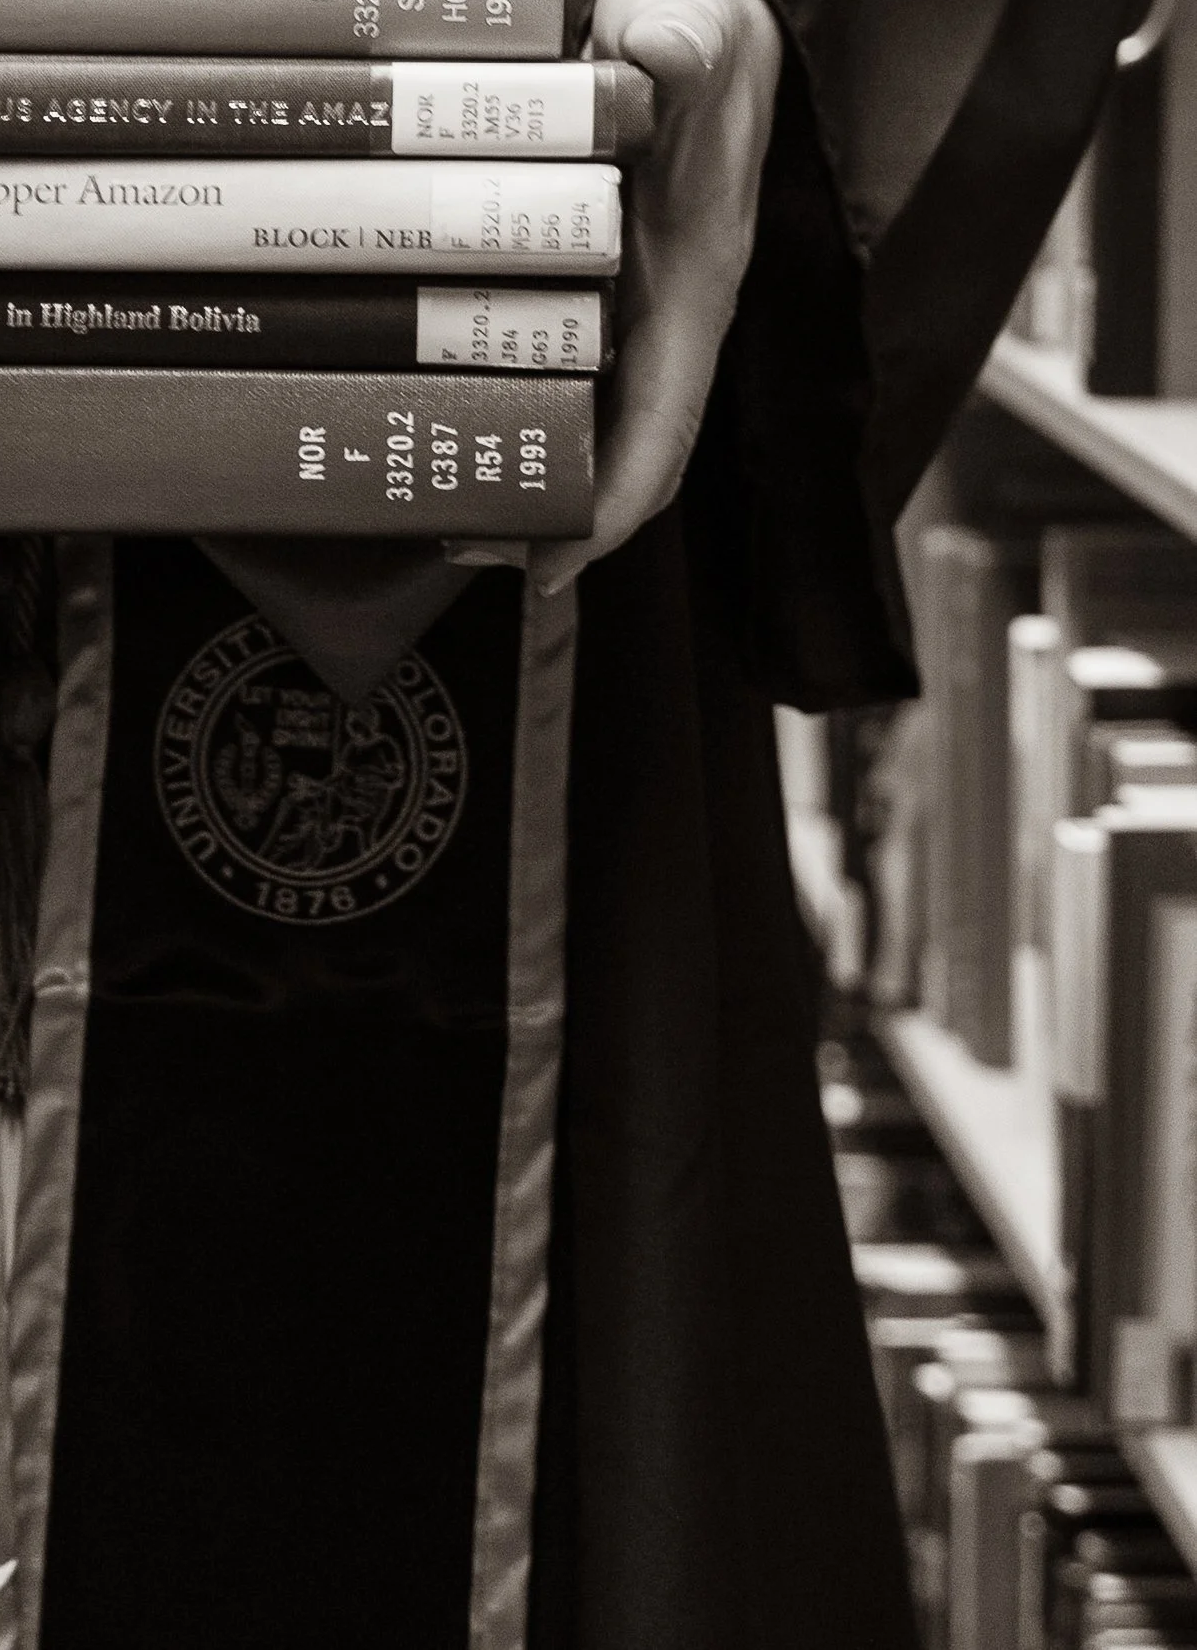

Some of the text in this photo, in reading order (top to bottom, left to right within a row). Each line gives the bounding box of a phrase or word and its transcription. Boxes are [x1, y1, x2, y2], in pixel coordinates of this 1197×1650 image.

[42, 97, 174, 124] AGENCY
[186, 99, 218, 125] IN
[228, 100, 290, 126] THE
[298, 101, 392, 127] AMAZ
[416, 94, 434, 139] NOR
[461, 81, 480, 141] 3320.2
[505, 102, 523, 139] V36
[527, 98, 545, 141] 2013
[439, 126, 455, 140] F
[75, 174, 224, 207] Amazon
[481, 178, 501, 250] 3320.2
[510, 212, 531, 251] M55
[540, 212, 561, 251] B56
[570, 201, 590, 251] 1994
[253, 227, 351, 249] BLOCK
[452, 236, 472, 250] F
[6, 301, 33, 328] in
[39, 301, 161, 335] Highland
[168, 305, 261, 333] Bolivia
[471, 289, 492, 362] 3320.2
[501, 327, 521, 363] J84
[531, 328, 550, 366] G63
[561, 317, 579, 367] 1990
[298, 425, 327, 481] NOR
[343, 446, 371, 462] F
[385, 410, 415, 502] 3320.2
[430, 421, 459, 491] C387
[474, 433, 503, 482] R54
[519, 428, 548, 491] 1993
[392, 659, 460, 871] OLORADO
[255, 881, 357, 914] 1876
